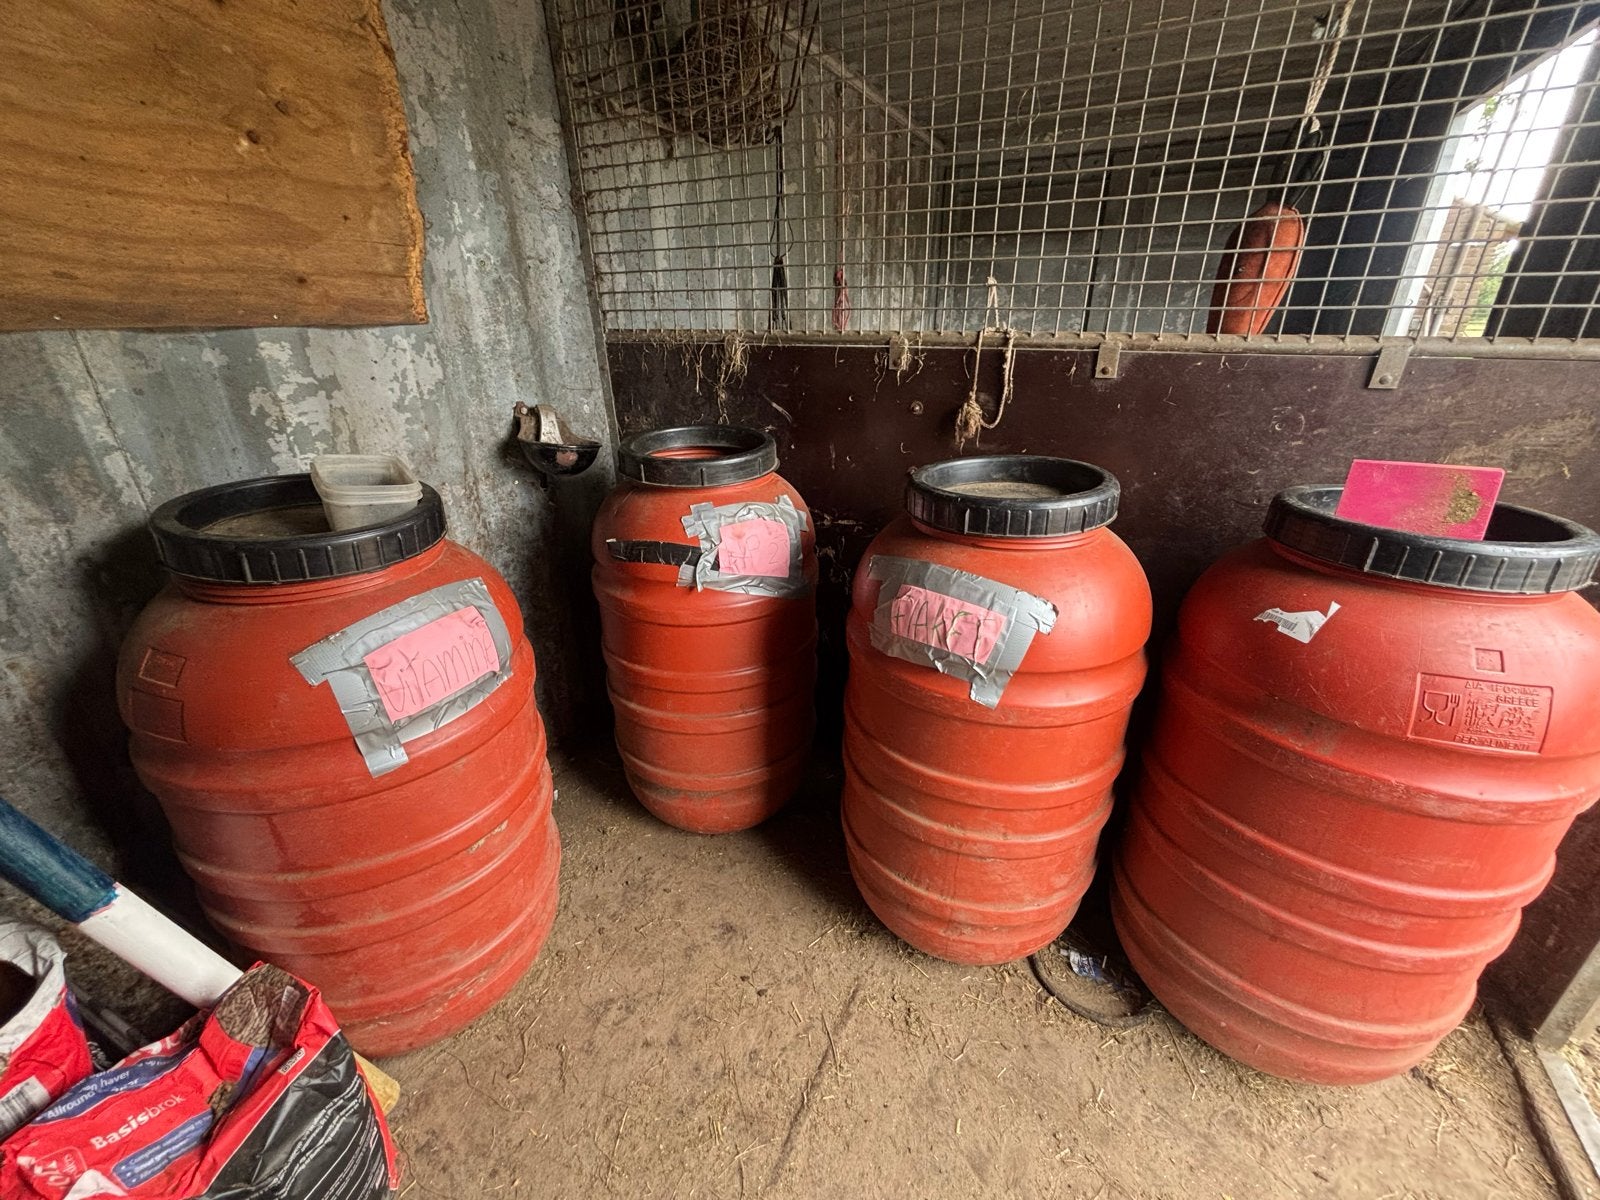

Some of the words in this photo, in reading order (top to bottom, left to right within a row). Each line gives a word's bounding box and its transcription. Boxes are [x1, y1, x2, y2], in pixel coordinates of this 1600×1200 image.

[1495, 693, 1540, 708] GREECE
[99, 1070, 131, 1092] haver
[89, 1094, 187, 1151] Basisbrok
